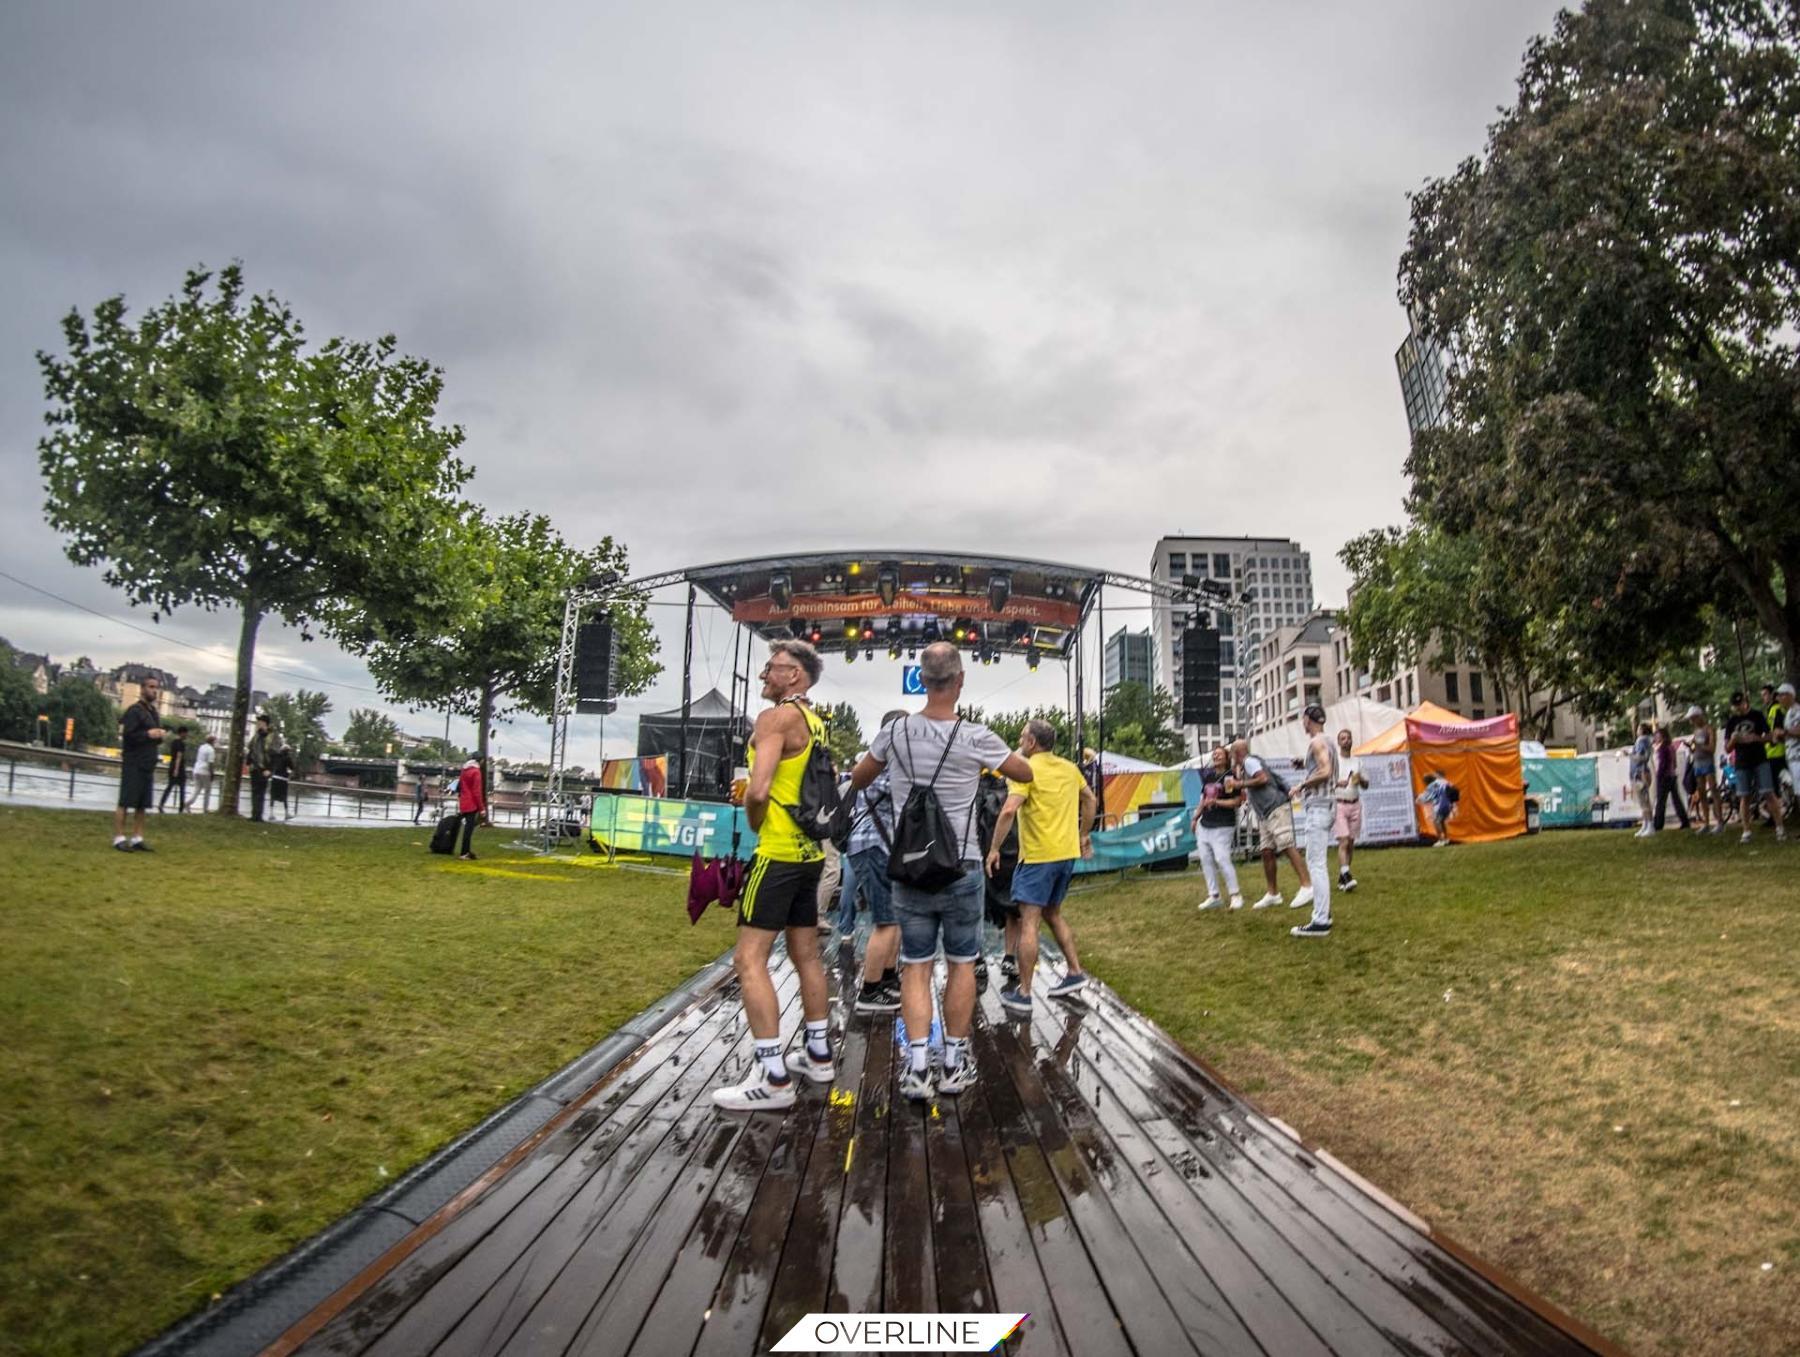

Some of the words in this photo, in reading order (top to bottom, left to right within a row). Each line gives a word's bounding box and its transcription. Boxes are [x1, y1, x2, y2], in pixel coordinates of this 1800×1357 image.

[792, 600, 859, 616] gemeinsam
[861, 599, 878, 611] für
[930, 599, 962, 613] Liebe
[669, 812, 717, 847] VGF
[1141, 816, 1183, 854] VGF
